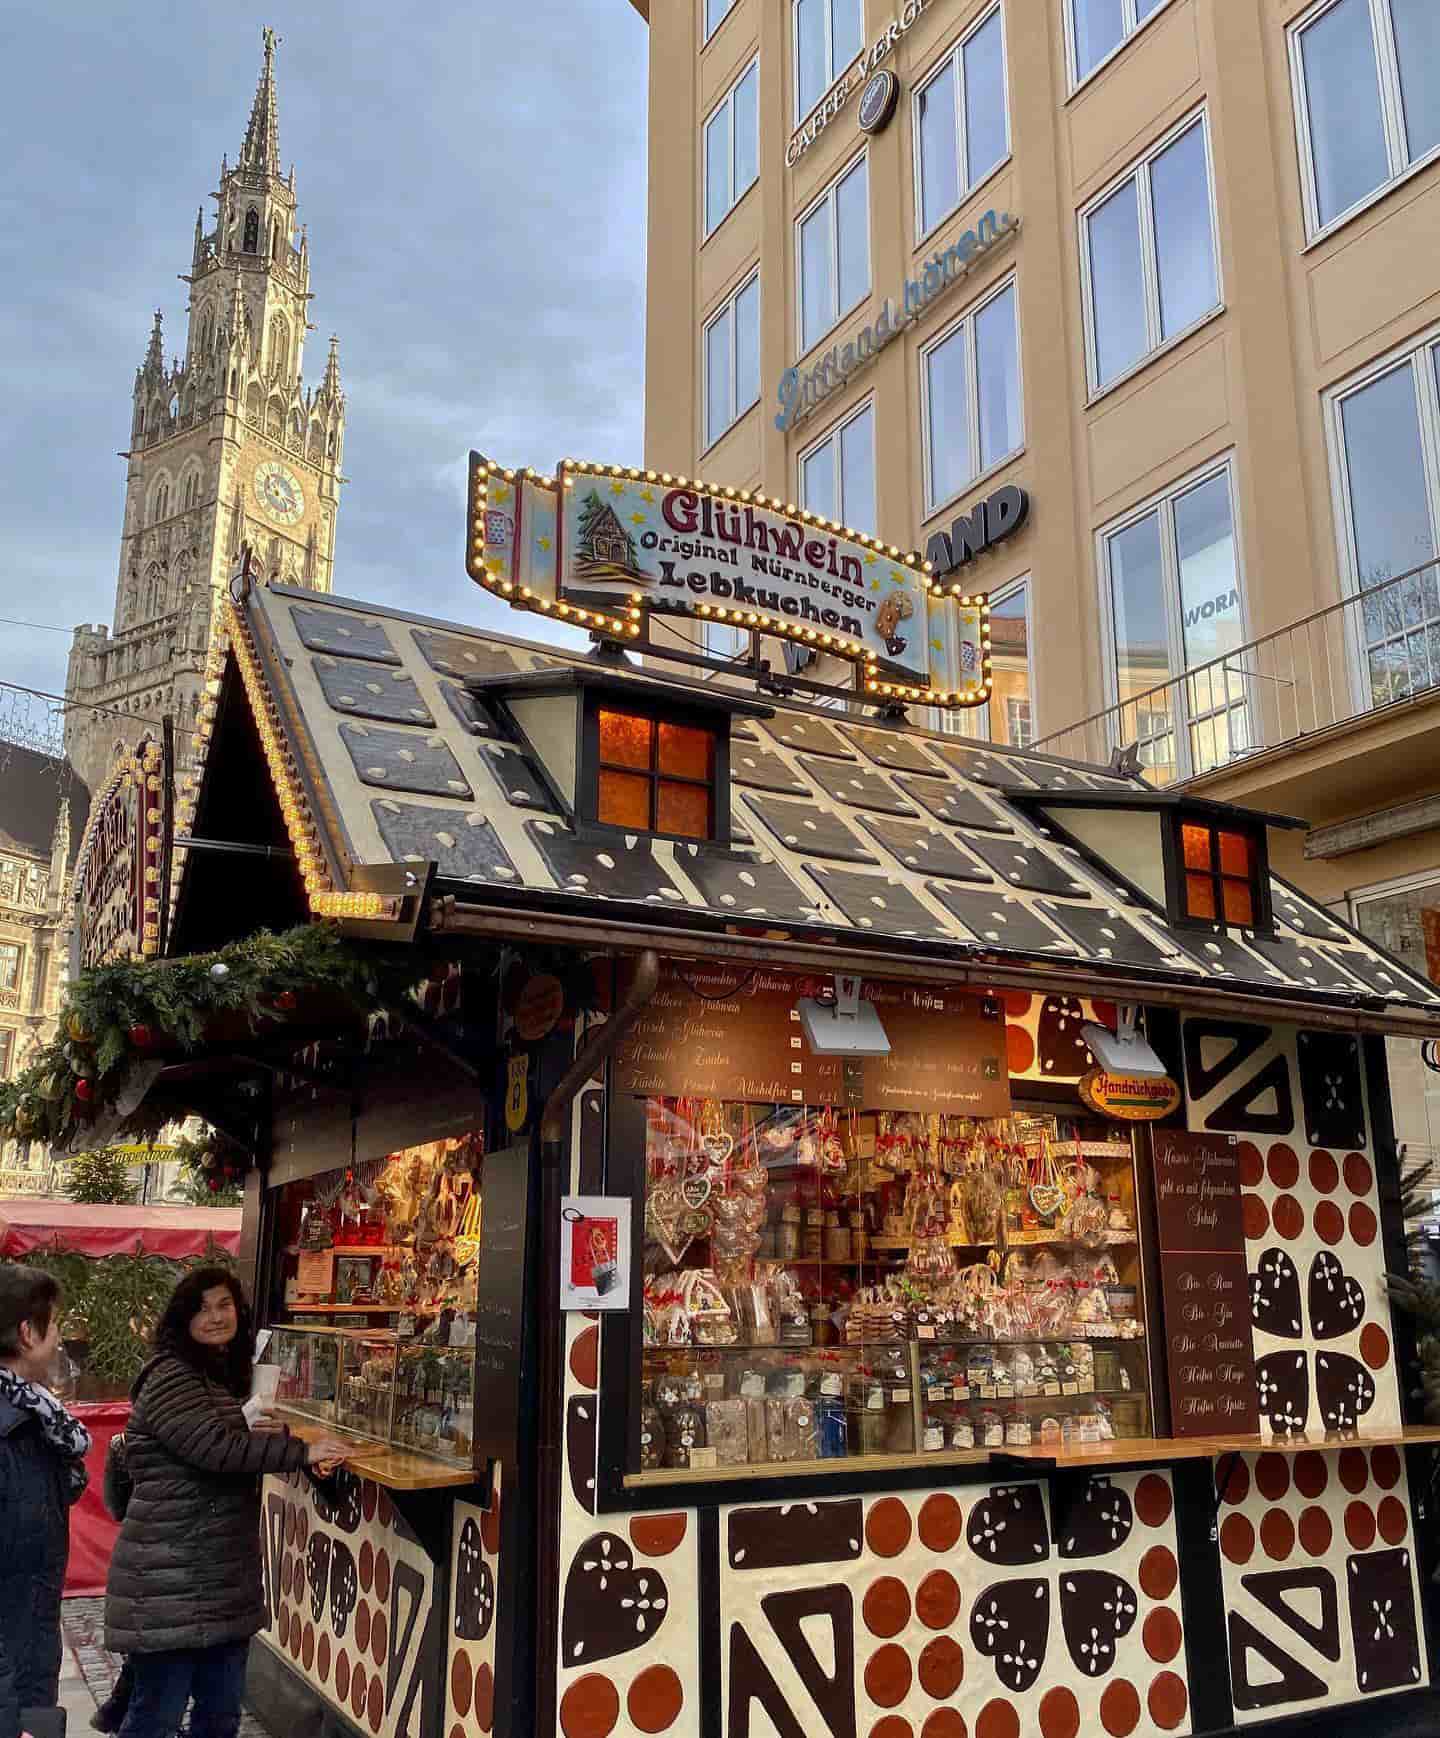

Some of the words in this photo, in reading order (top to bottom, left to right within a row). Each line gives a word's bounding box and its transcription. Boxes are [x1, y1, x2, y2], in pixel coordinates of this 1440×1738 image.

[640, 531, 738, 566] Original
[751, 554, 876, 611] Nürnberger
[662, 489, 864, 588] Glühwein
[659, 561, 863, 639] Lebkuchen
